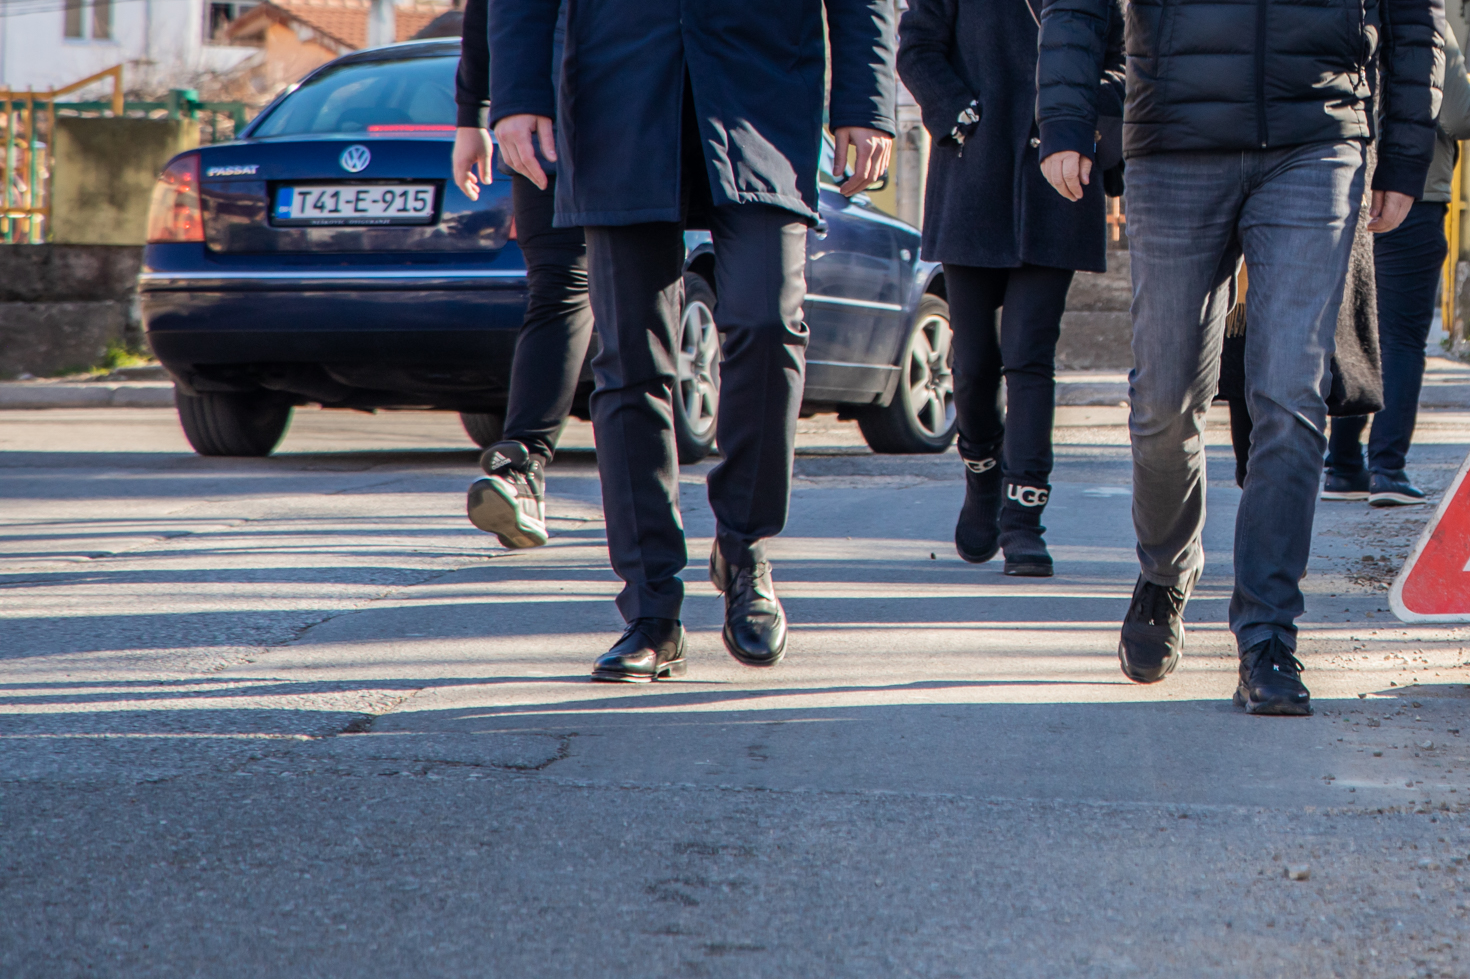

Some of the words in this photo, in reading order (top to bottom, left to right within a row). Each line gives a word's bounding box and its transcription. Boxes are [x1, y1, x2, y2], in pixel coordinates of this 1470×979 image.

[207, 165, 260, 176] PASSAT
[298, 189, 430, 214] T41-E-915
[963, 458, 997, 473] GG
[1007, 484, 1048, 507] UGG
